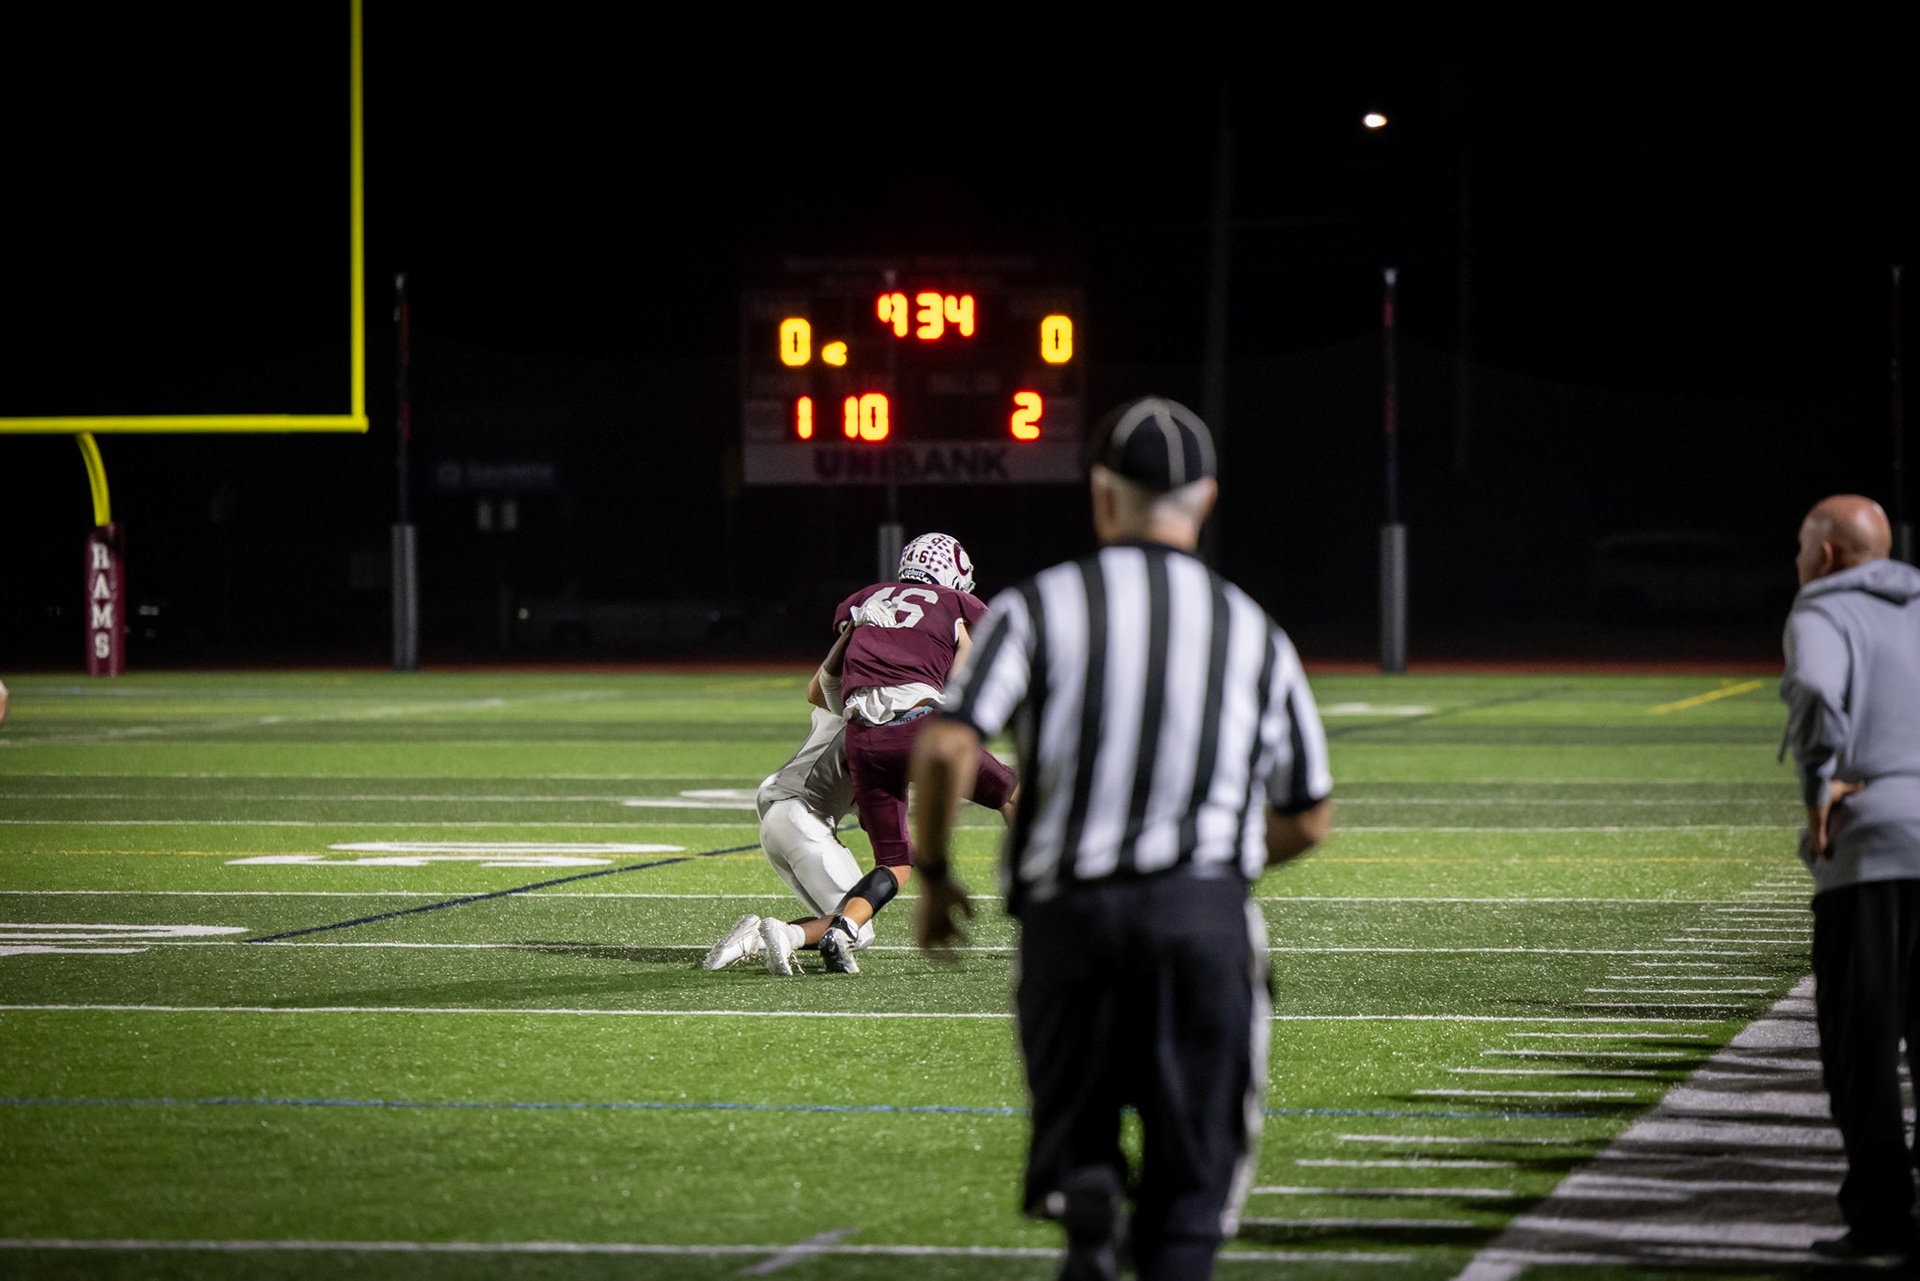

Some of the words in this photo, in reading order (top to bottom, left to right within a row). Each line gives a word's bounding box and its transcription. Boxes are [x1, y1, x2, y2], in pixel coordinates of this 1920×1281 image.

[780, 317, 811, 366] 0
[1041, 314, 1073, 364] 0
[797, 395, 813, 440] 1
[844, 392, 889, 442] 10
[1011, 391, 1043, 441] 2
[814, 447, 1008, 478] UNIBANK
[91, 542, 113, 660] RAMS
